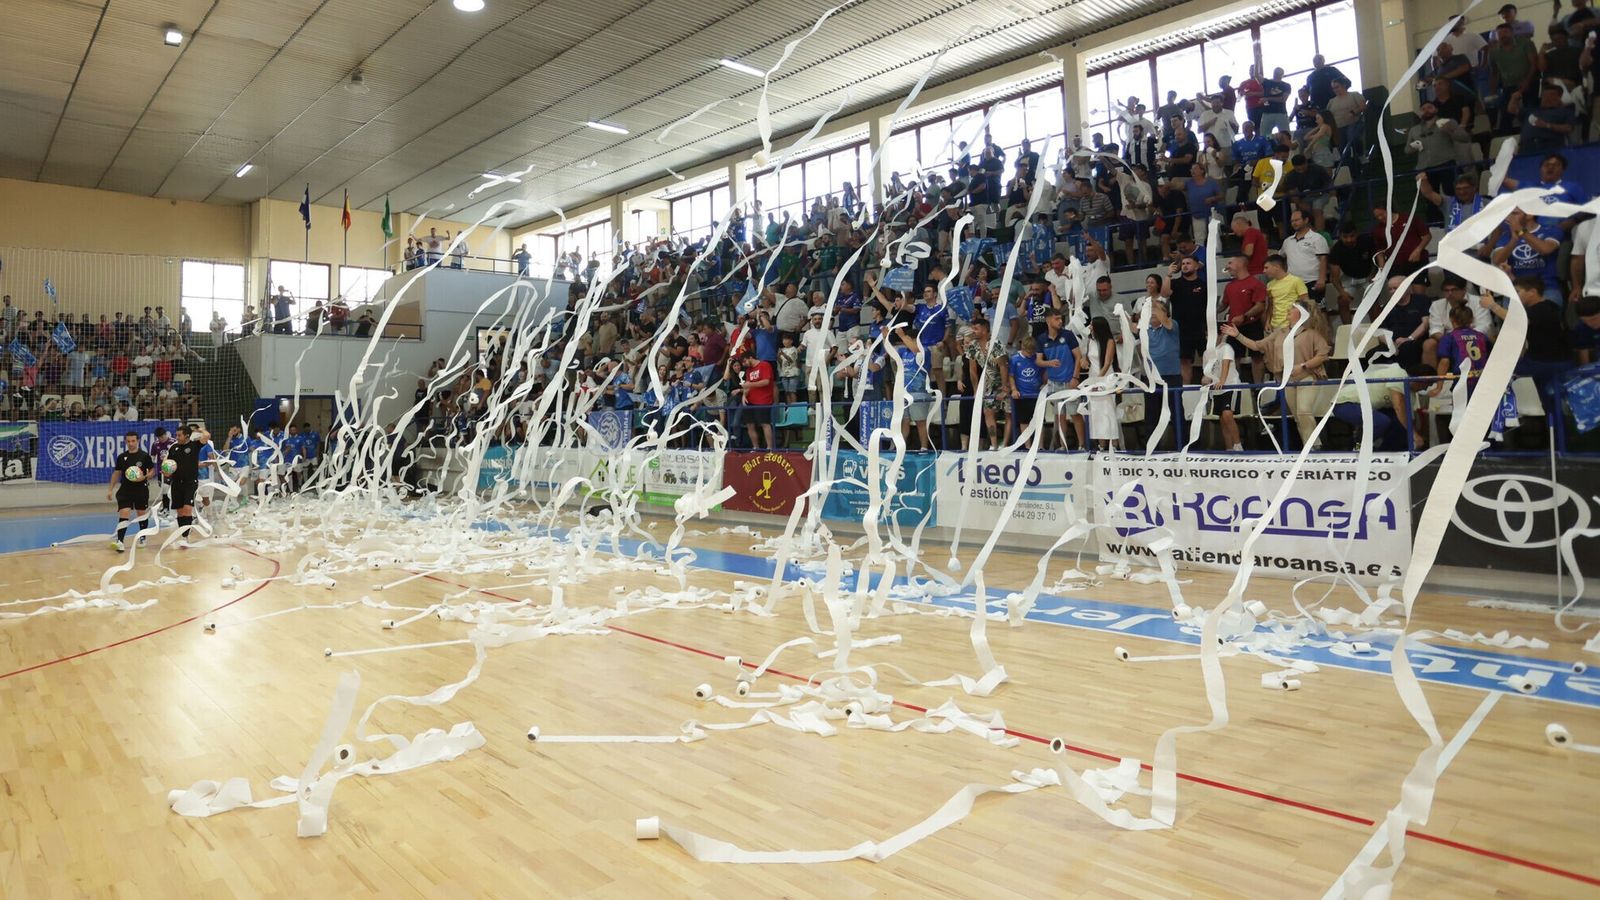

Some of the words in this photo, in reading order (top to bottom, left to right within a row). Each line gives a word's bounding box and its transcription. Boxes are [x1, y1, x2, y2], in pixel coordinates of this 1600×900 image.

[1466, 341, 1481, 361] 6
[742, 456, 761, 474] Bar
[1163, 468, 1259, 479] QURURGICO
[1266, 469, 1275, 479] Y
[1012, 510, 1025, 519] 644
[1027, 511, 1036, 520] 29
[1037, 512, 1045, 521] 37
[1048, 512, 1057, 522] 10
